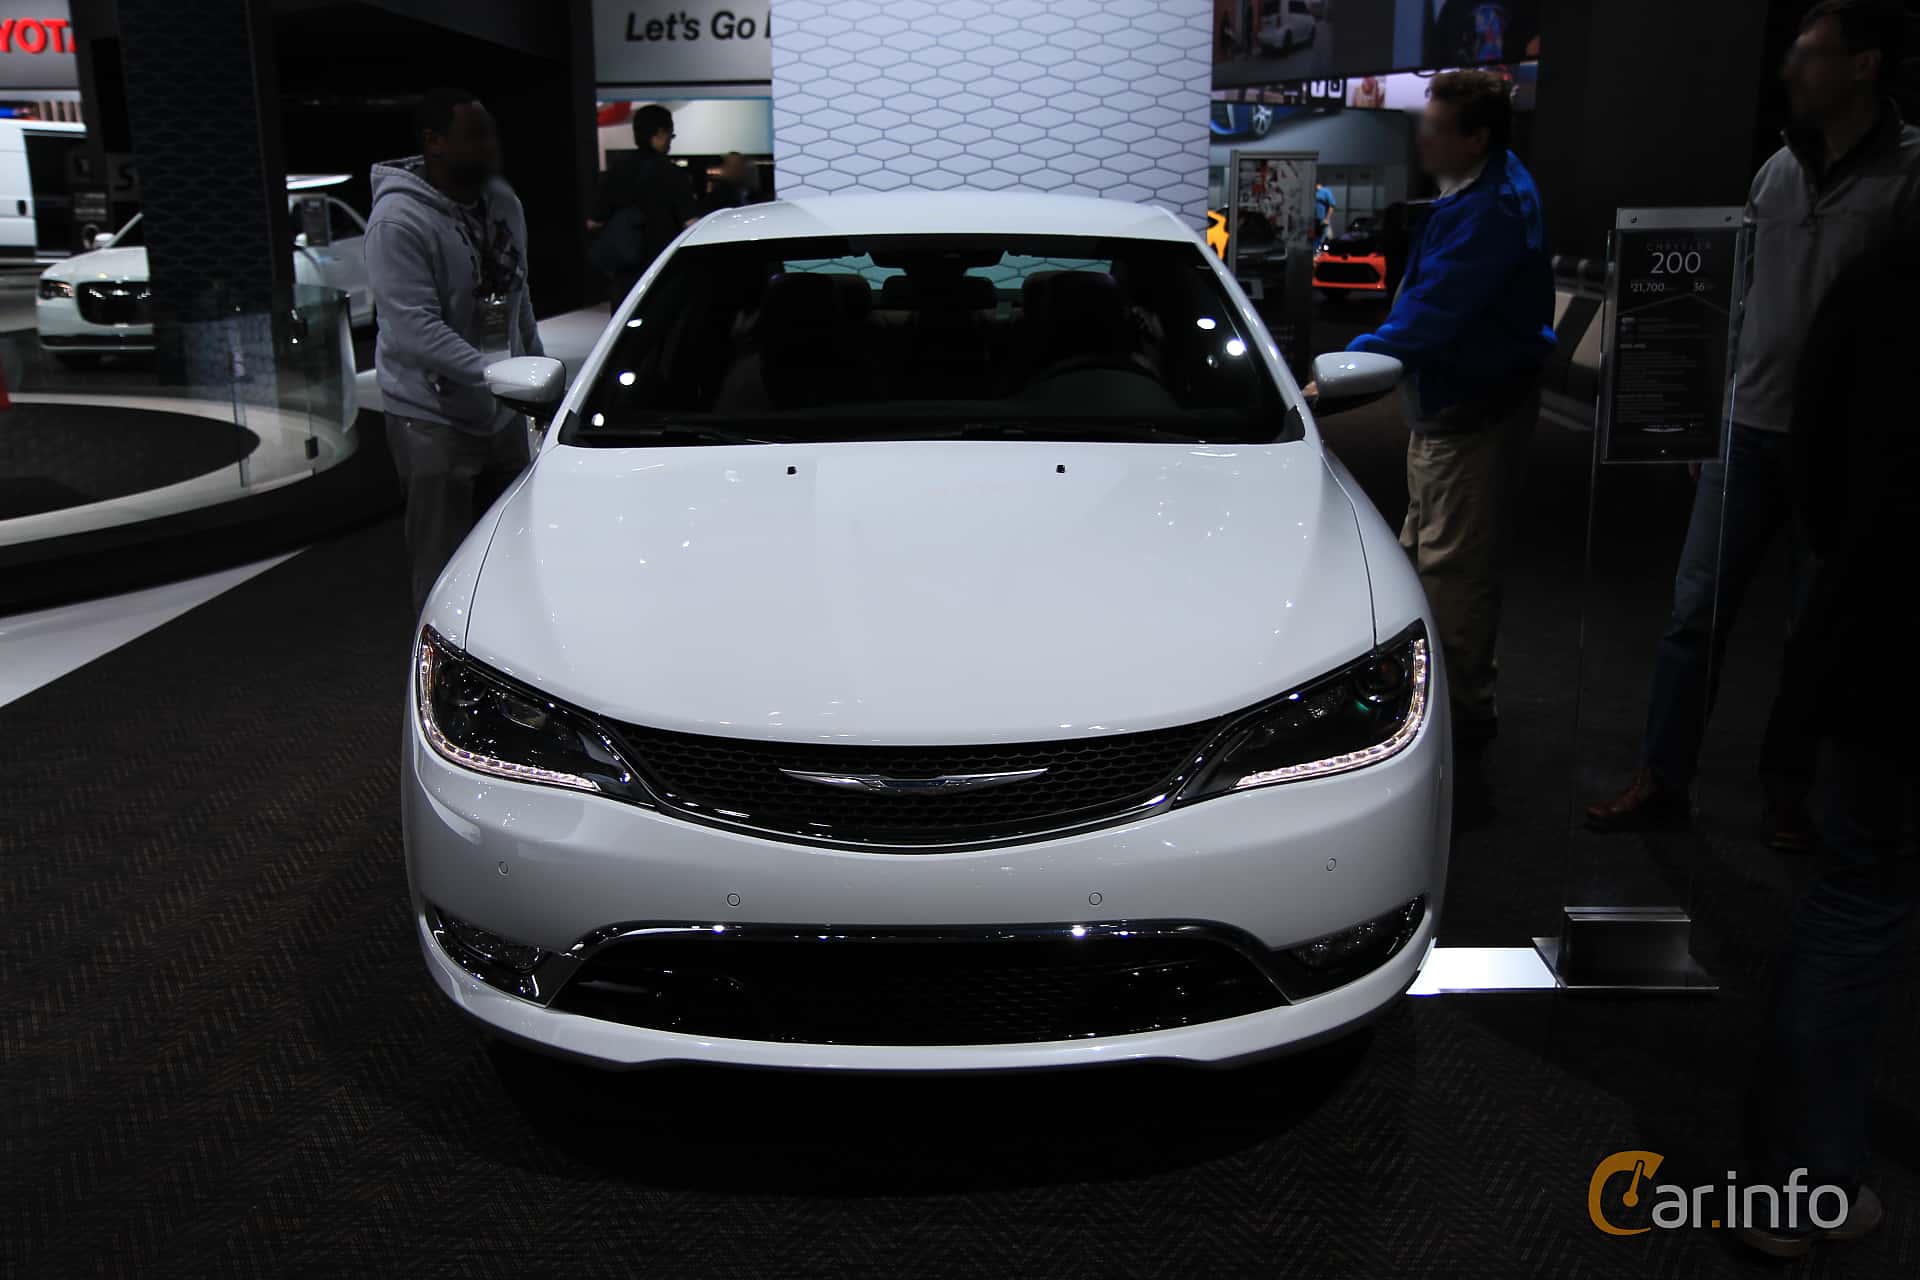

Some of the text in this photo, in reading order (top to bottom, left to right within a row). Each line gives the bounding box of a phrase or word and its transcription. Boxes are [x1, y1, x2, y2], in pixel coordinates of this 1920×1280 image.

[626, 11, 700, 42] Let's
[711, 10, 756, 40] Go
[1650, 251, 1702, 274] 200
